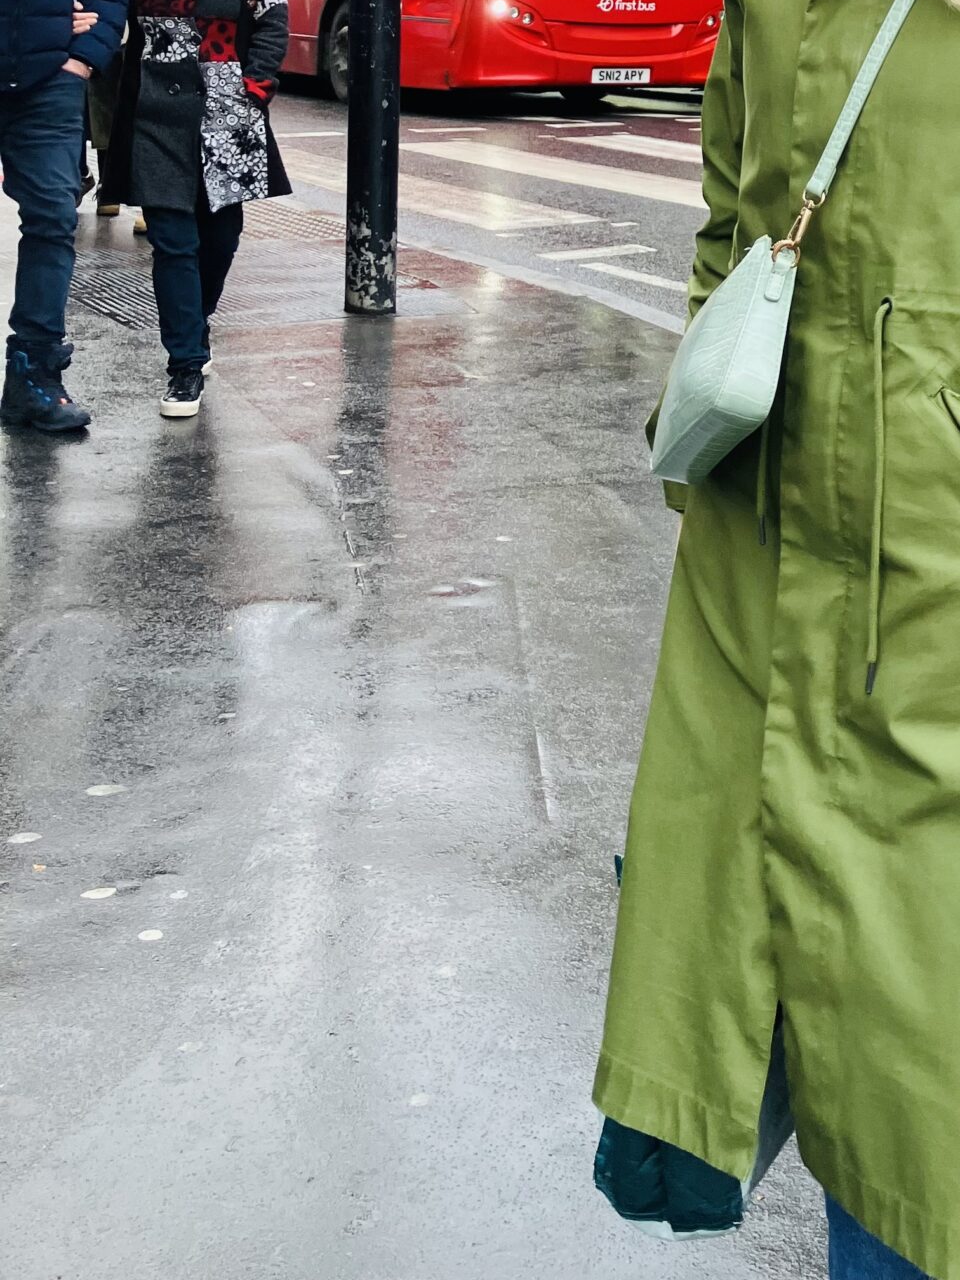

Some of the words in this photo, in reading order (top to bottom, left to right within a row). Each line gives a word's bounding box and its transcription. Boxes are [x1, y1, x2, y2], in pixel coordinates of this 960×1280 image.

[614, 0, 637, 11] first
[637, 0, 656, 11] bus
[599, 70, 621, 80] SN12
[624, 70, 644, 81] APY
